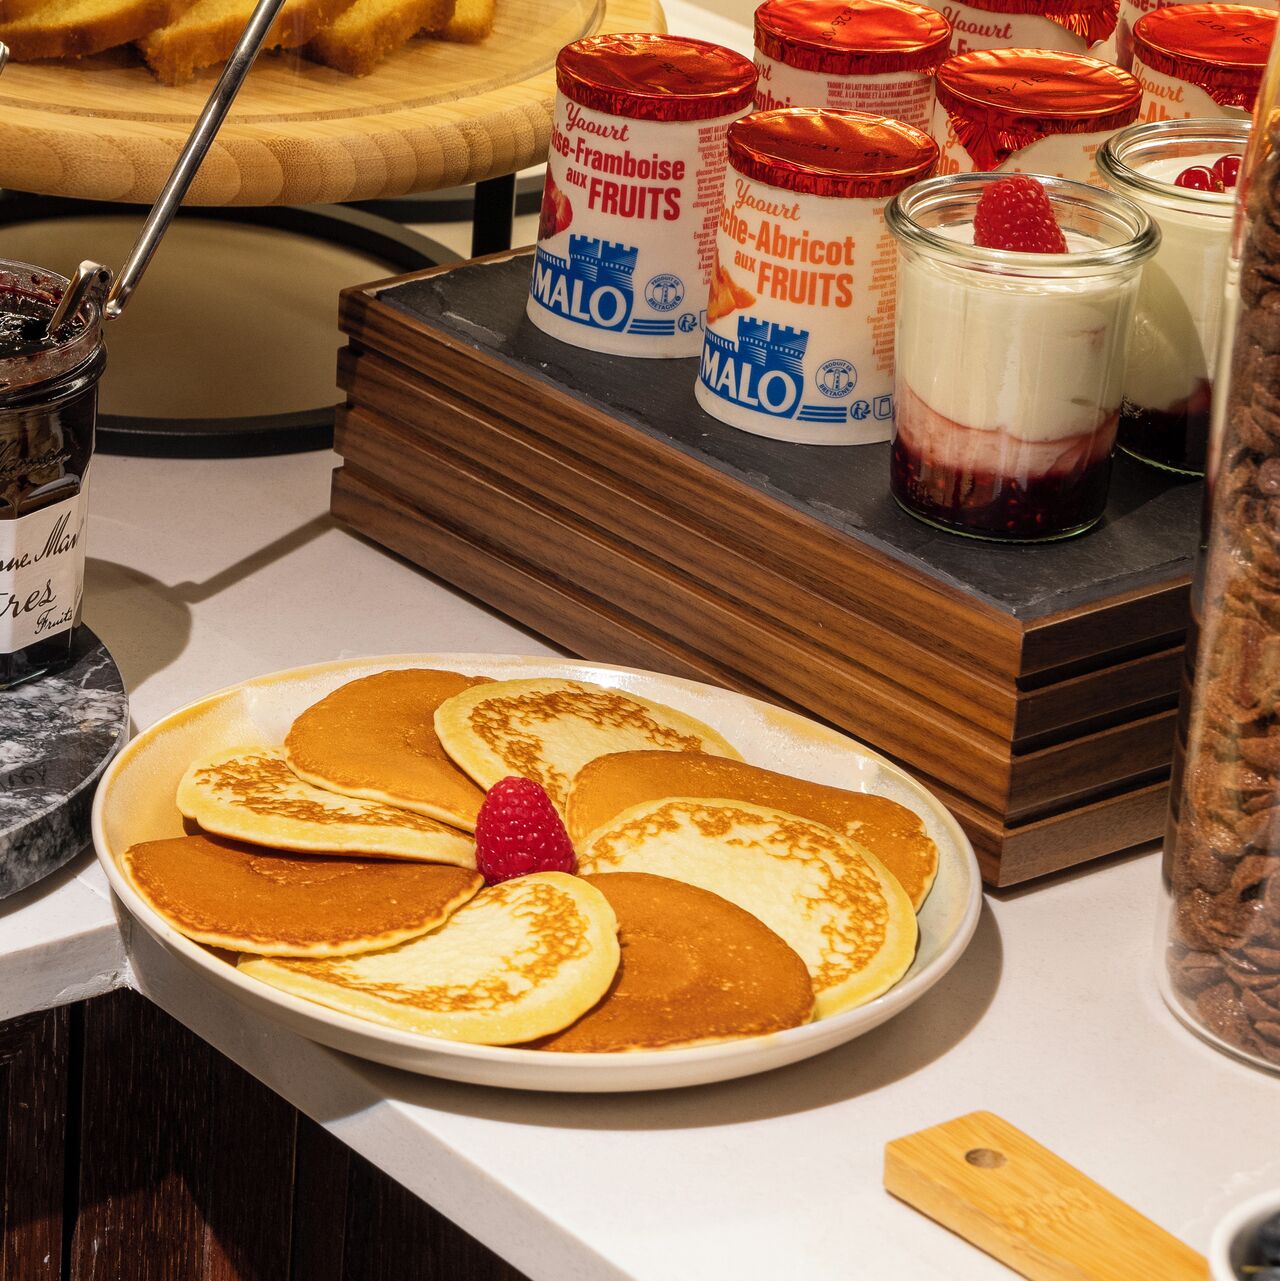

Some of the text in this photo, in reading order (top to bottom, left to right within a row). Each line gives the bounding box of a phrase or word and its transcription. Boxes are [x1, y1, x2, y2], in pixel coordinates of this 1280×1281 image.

[942, 6, 1013, 40] Yaourt
[566, 102, 629, 142] Yaourt
[566, 167, 681, 221] aux FRUITS
[735, 178, 801, 221] Yaourt
[533, 262, 627, 327] MALO
[734, 250, 757, 273] aux
[756, 262, 854, 308] FRUITS
[700, 344, 797, 414] MALO
[34, 605, 73, 635] Fruits
